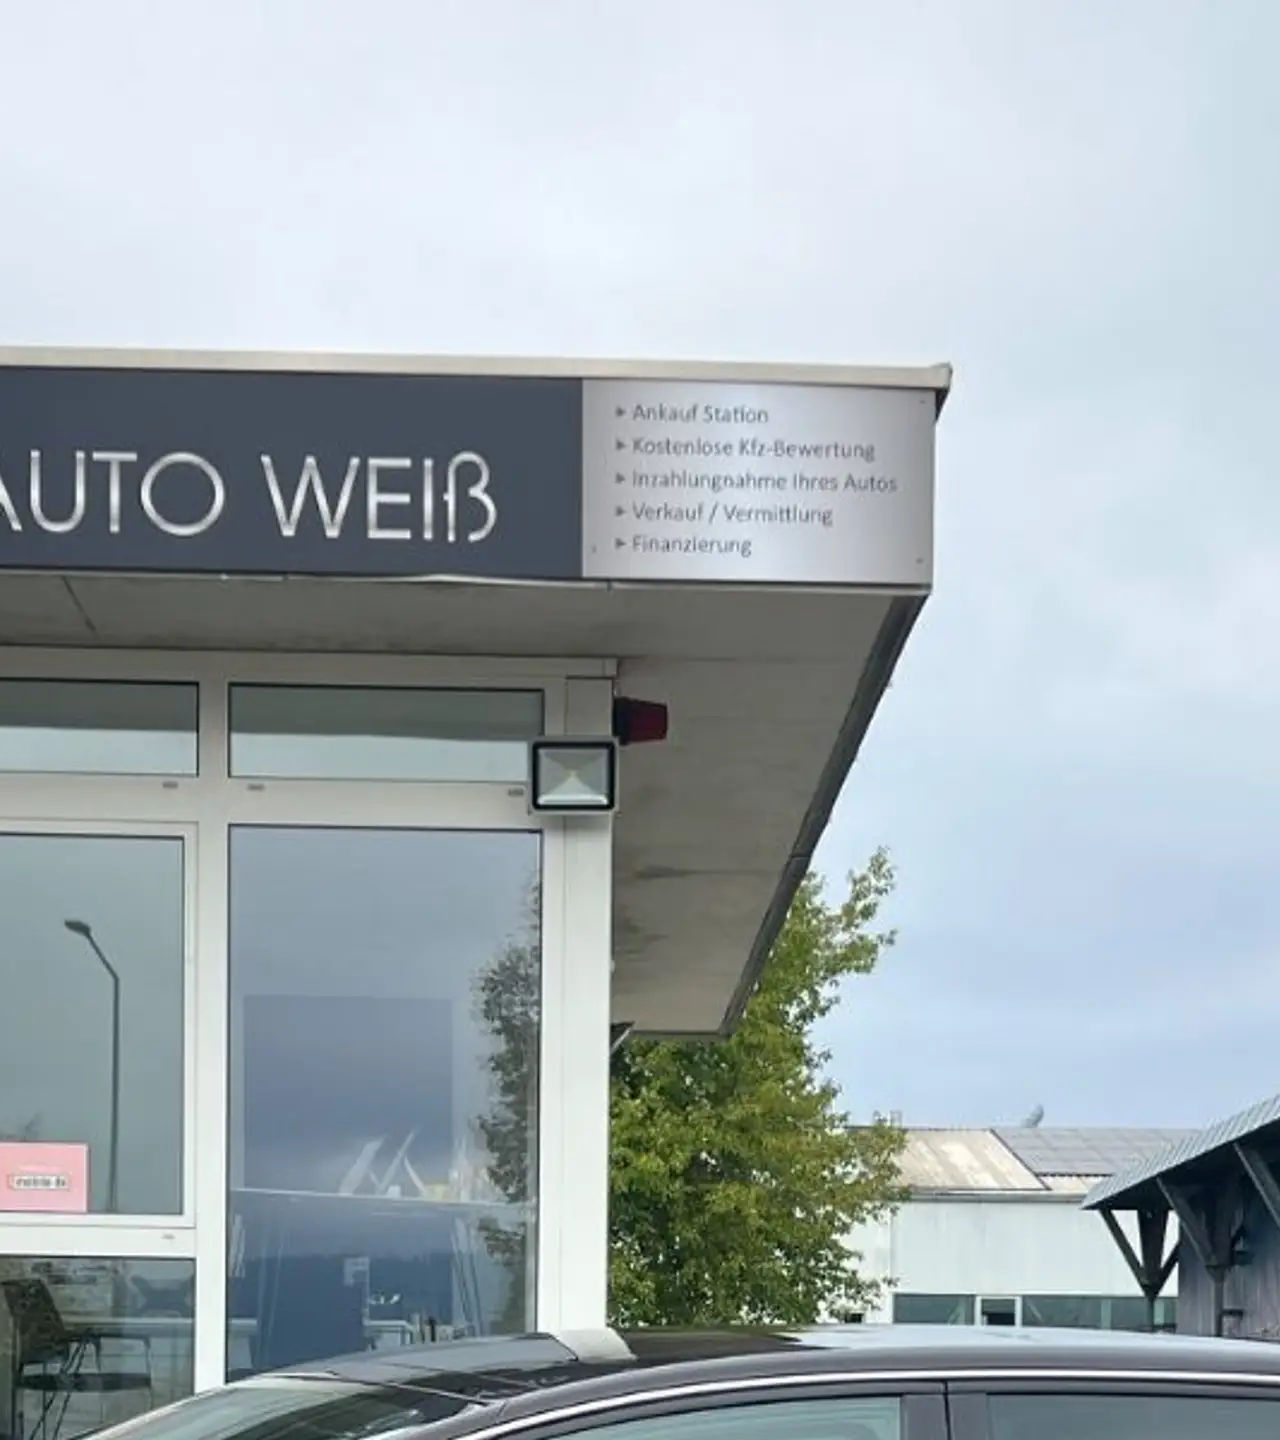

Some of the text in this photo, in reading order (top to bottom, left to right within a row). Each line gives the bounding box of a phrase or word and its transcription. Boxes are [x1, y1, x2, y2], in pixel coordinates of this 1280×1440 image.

[631, 404, 769, 424] Ankauf Station
[632, 437, 876, 461] Kostenlose Kfz-Bewertung
[632, 470, 898, 493] Inzahlungnahme Ihres Autos
[260, 451, 497, 543] WEIß
[631, 502, 834, 526] Verkauf / Vermittlung
[632, 536, 752, 557] Finanzierung
